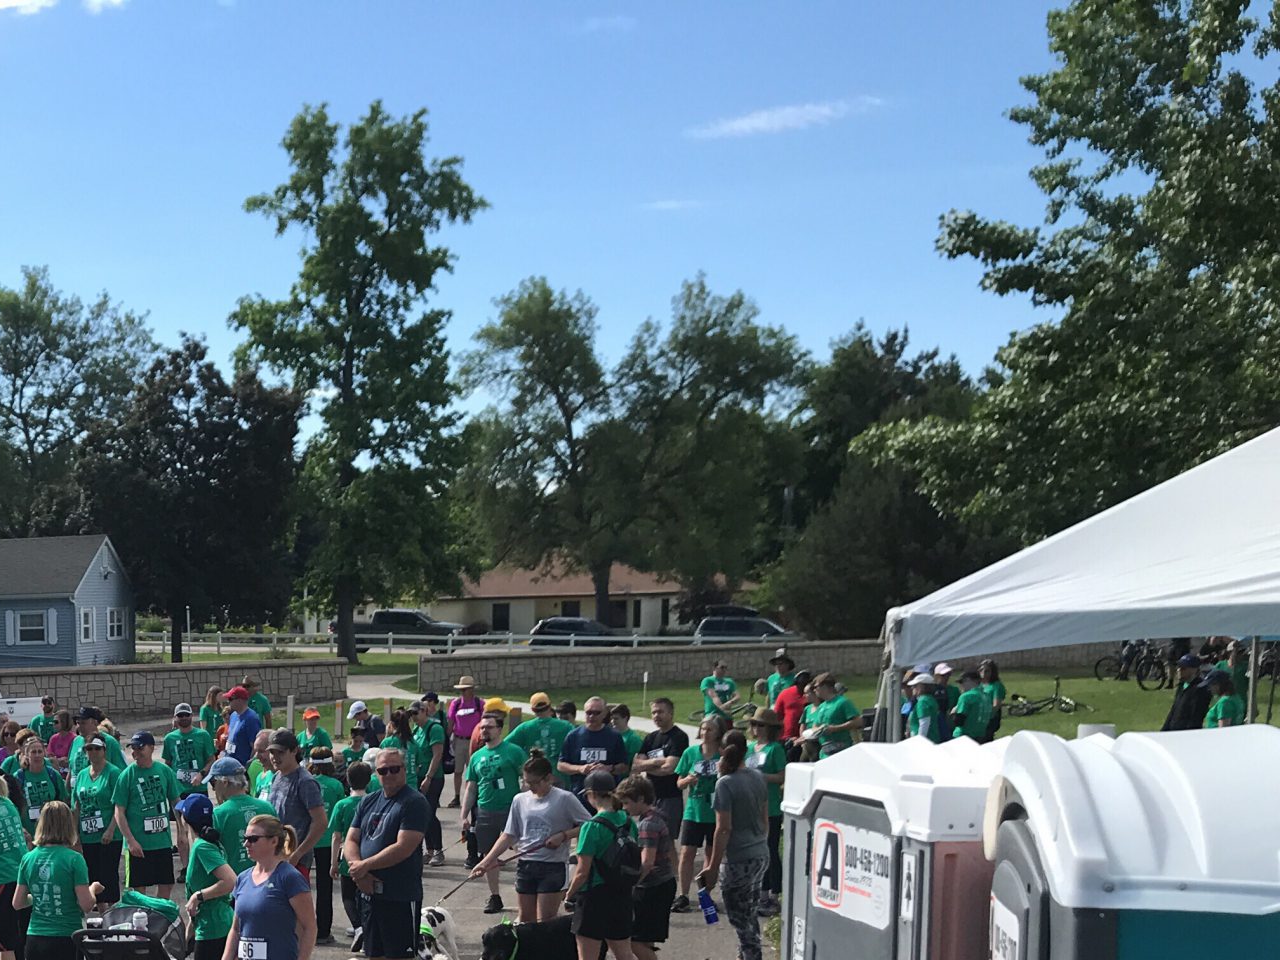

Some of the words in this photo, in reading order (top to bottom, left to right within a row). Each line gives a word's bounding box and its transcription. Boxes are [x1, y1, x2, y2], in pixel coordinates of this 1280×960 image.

[151, 819, 164, 829] 100
[817, 831, 839, 891] A
[243, 943, 254, 958] 96
